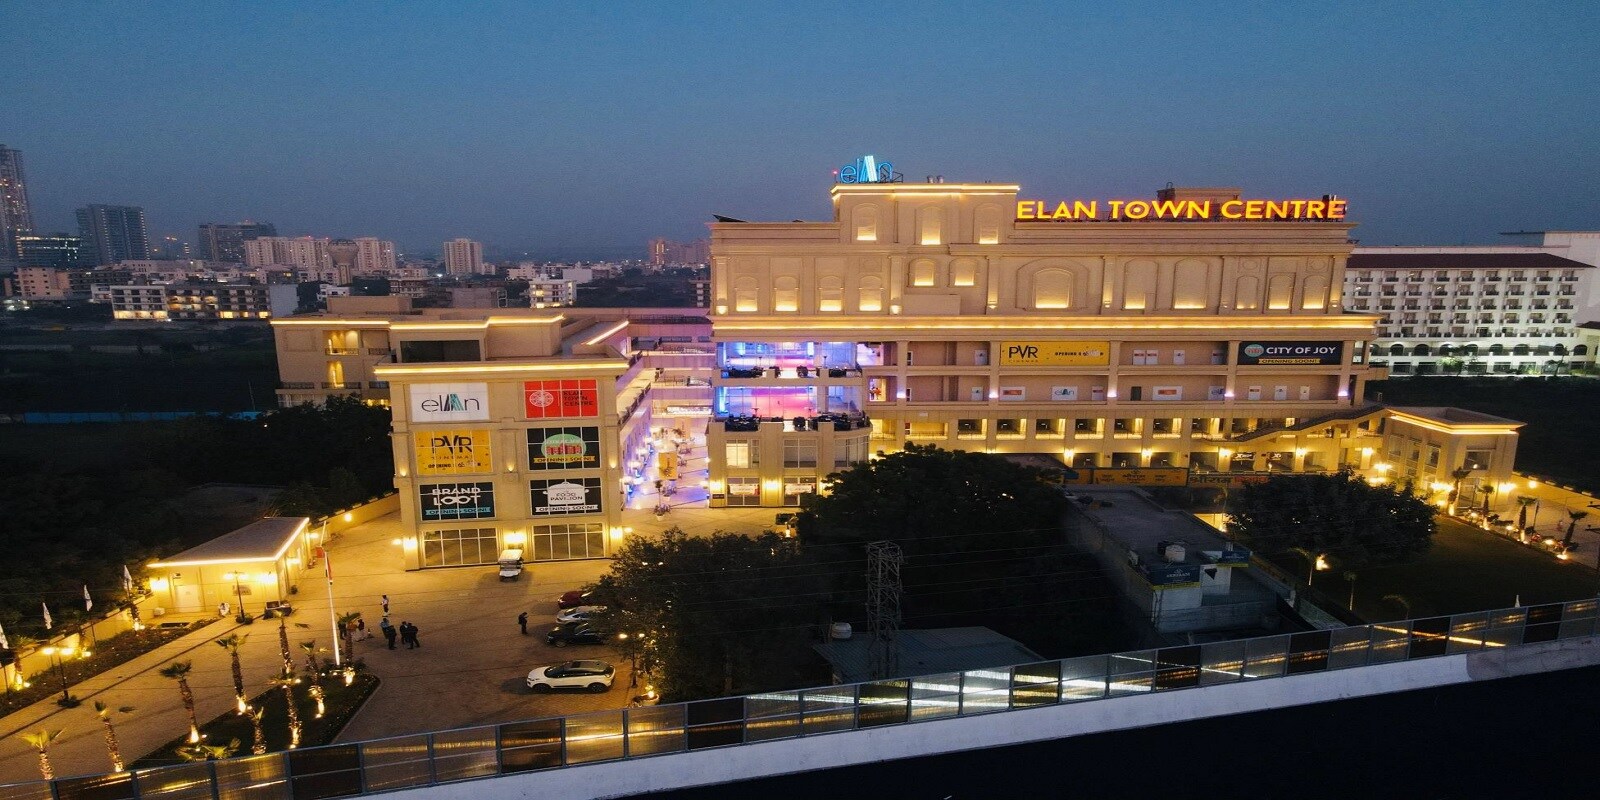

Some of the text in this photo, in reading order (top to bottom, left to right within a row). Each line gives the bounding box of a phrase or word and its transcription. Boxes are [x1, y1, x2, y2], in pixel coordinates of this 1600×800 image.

[1016, 199, 1346, 219] ELAN TOWN CENTRE
[1008, 345, 1038, 359] PVR
[431, 435, 473, 455] PVR
[432, 487, 481, 495] BRAND
[433, 495, 481, 506] LOOT
